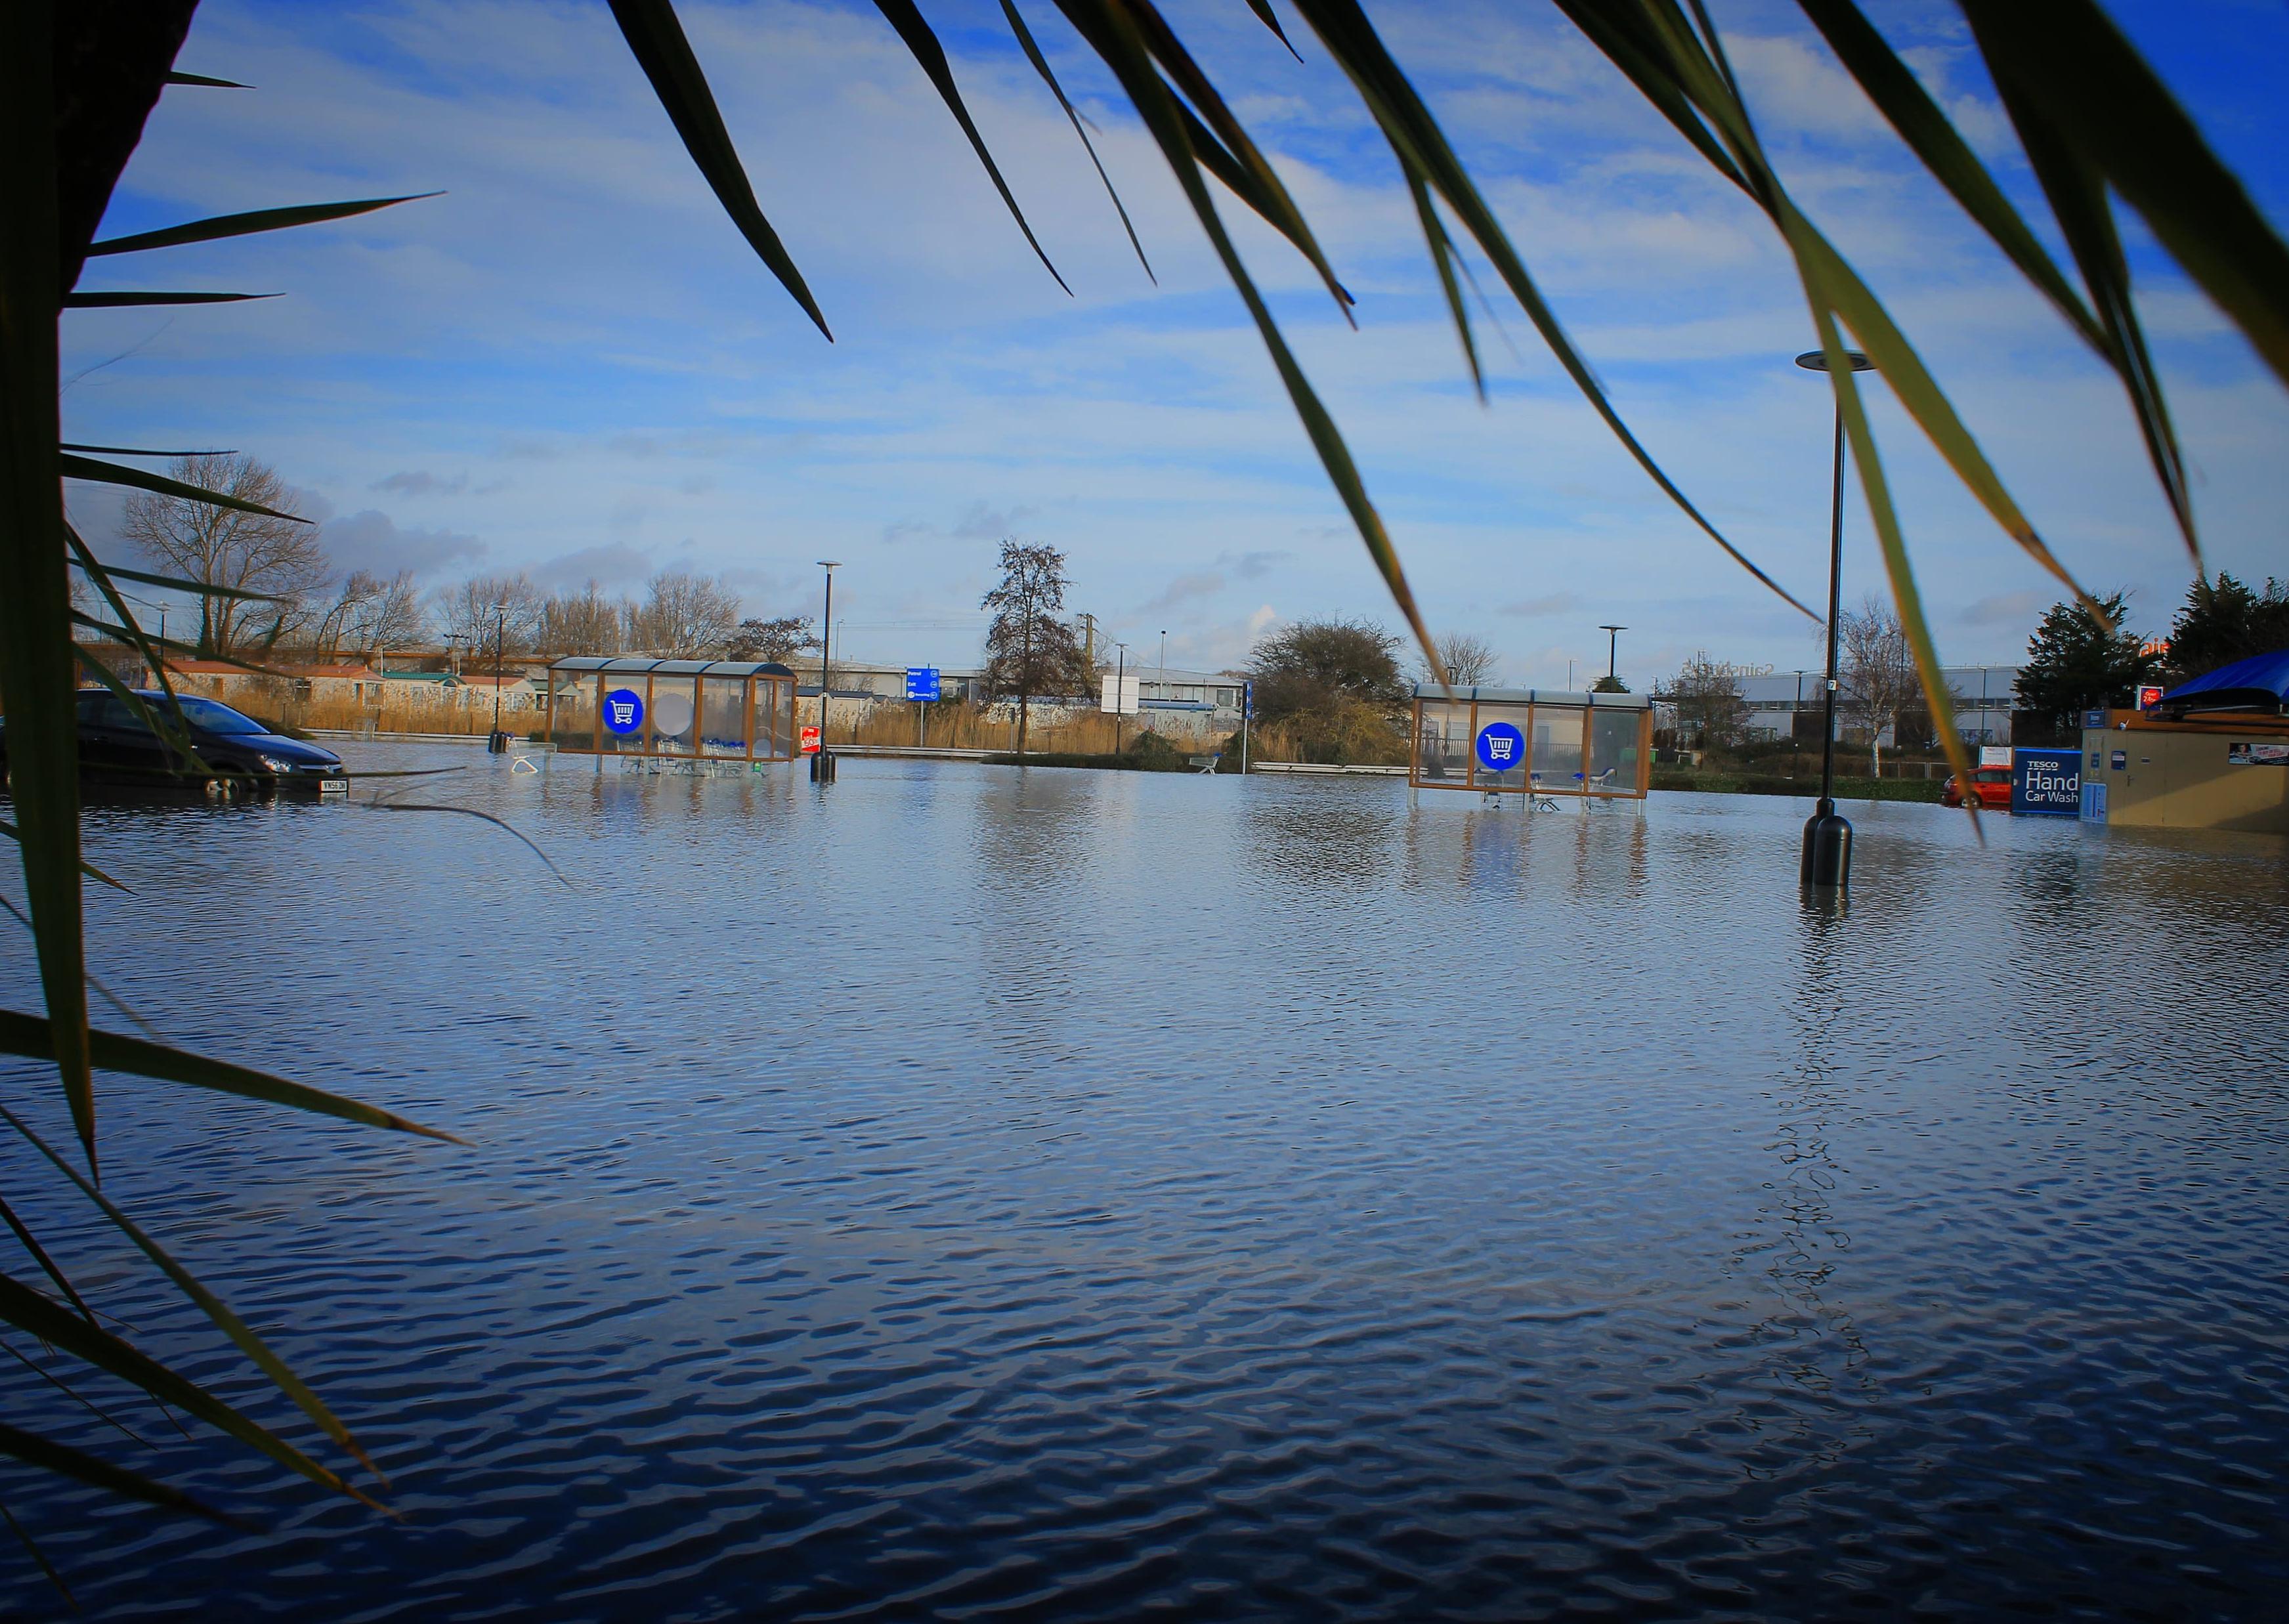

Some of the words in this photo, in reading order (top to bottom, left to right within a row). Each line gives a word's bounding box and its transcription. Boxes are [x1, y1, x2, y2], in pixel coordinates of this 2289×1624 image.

[2026, 771, 2079, 791] Hand
[2025, 790, 2045, 801] Car
[2047, 792, 2079, 803] Wash
